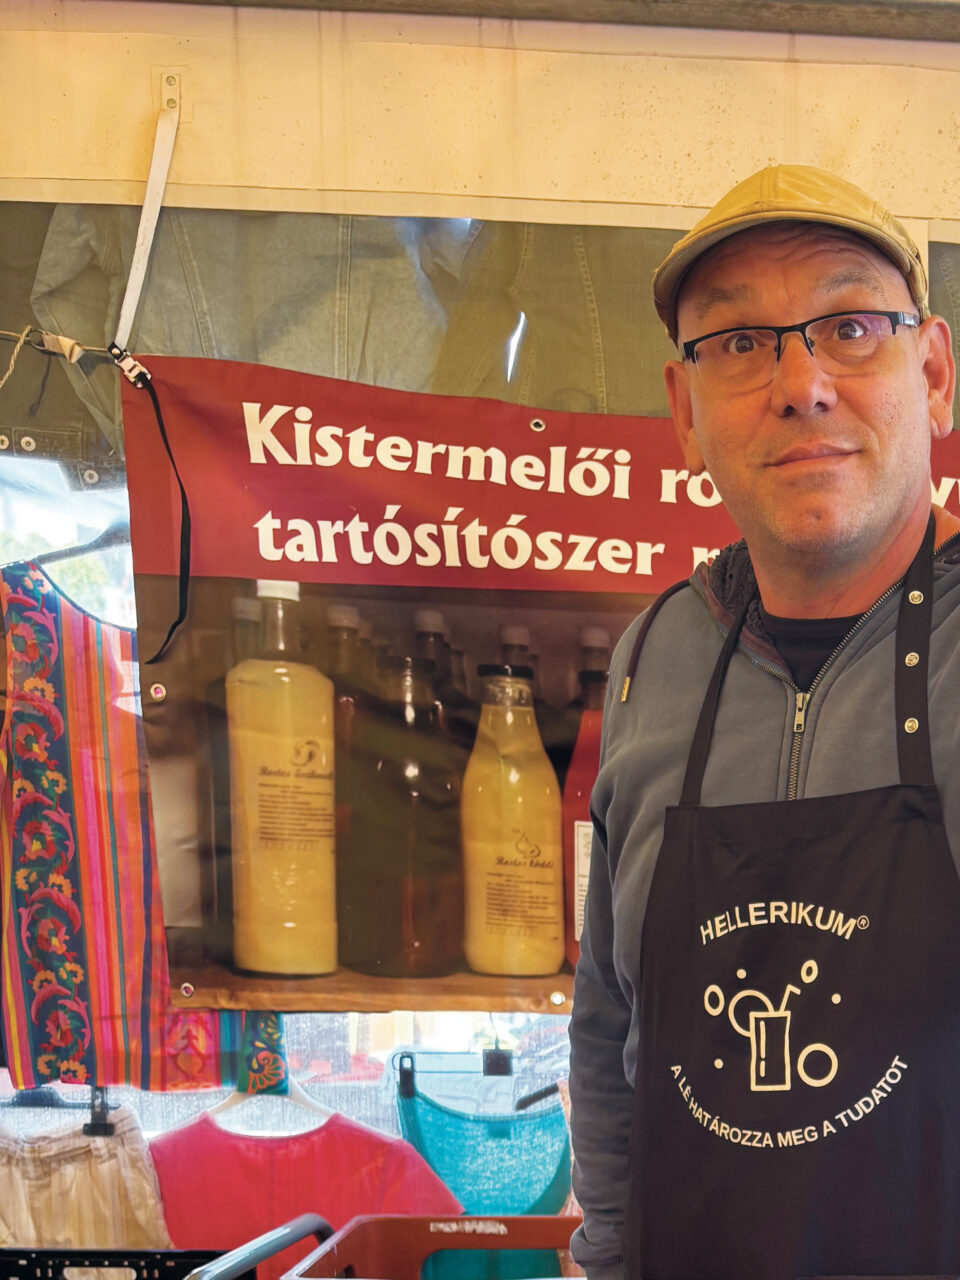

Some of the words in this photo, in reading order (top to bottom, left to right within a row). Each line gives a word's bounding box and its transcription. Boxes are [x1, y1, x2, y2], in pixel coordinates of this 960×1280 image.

[242, 401, 632, 500] Kistermelői
[253, 504, 666, 576] tartósítószer
[670, 1064, 682, 1080] A
[678, 1076, 691, 1103] LÉ
[688, 1099, 774, 1148] HATÁROZZA
[777, 1125, 819, 1148] MEG
[822, 1119, 836, 1138] A
[834, 1055, 908, 1128] TUDATOT
